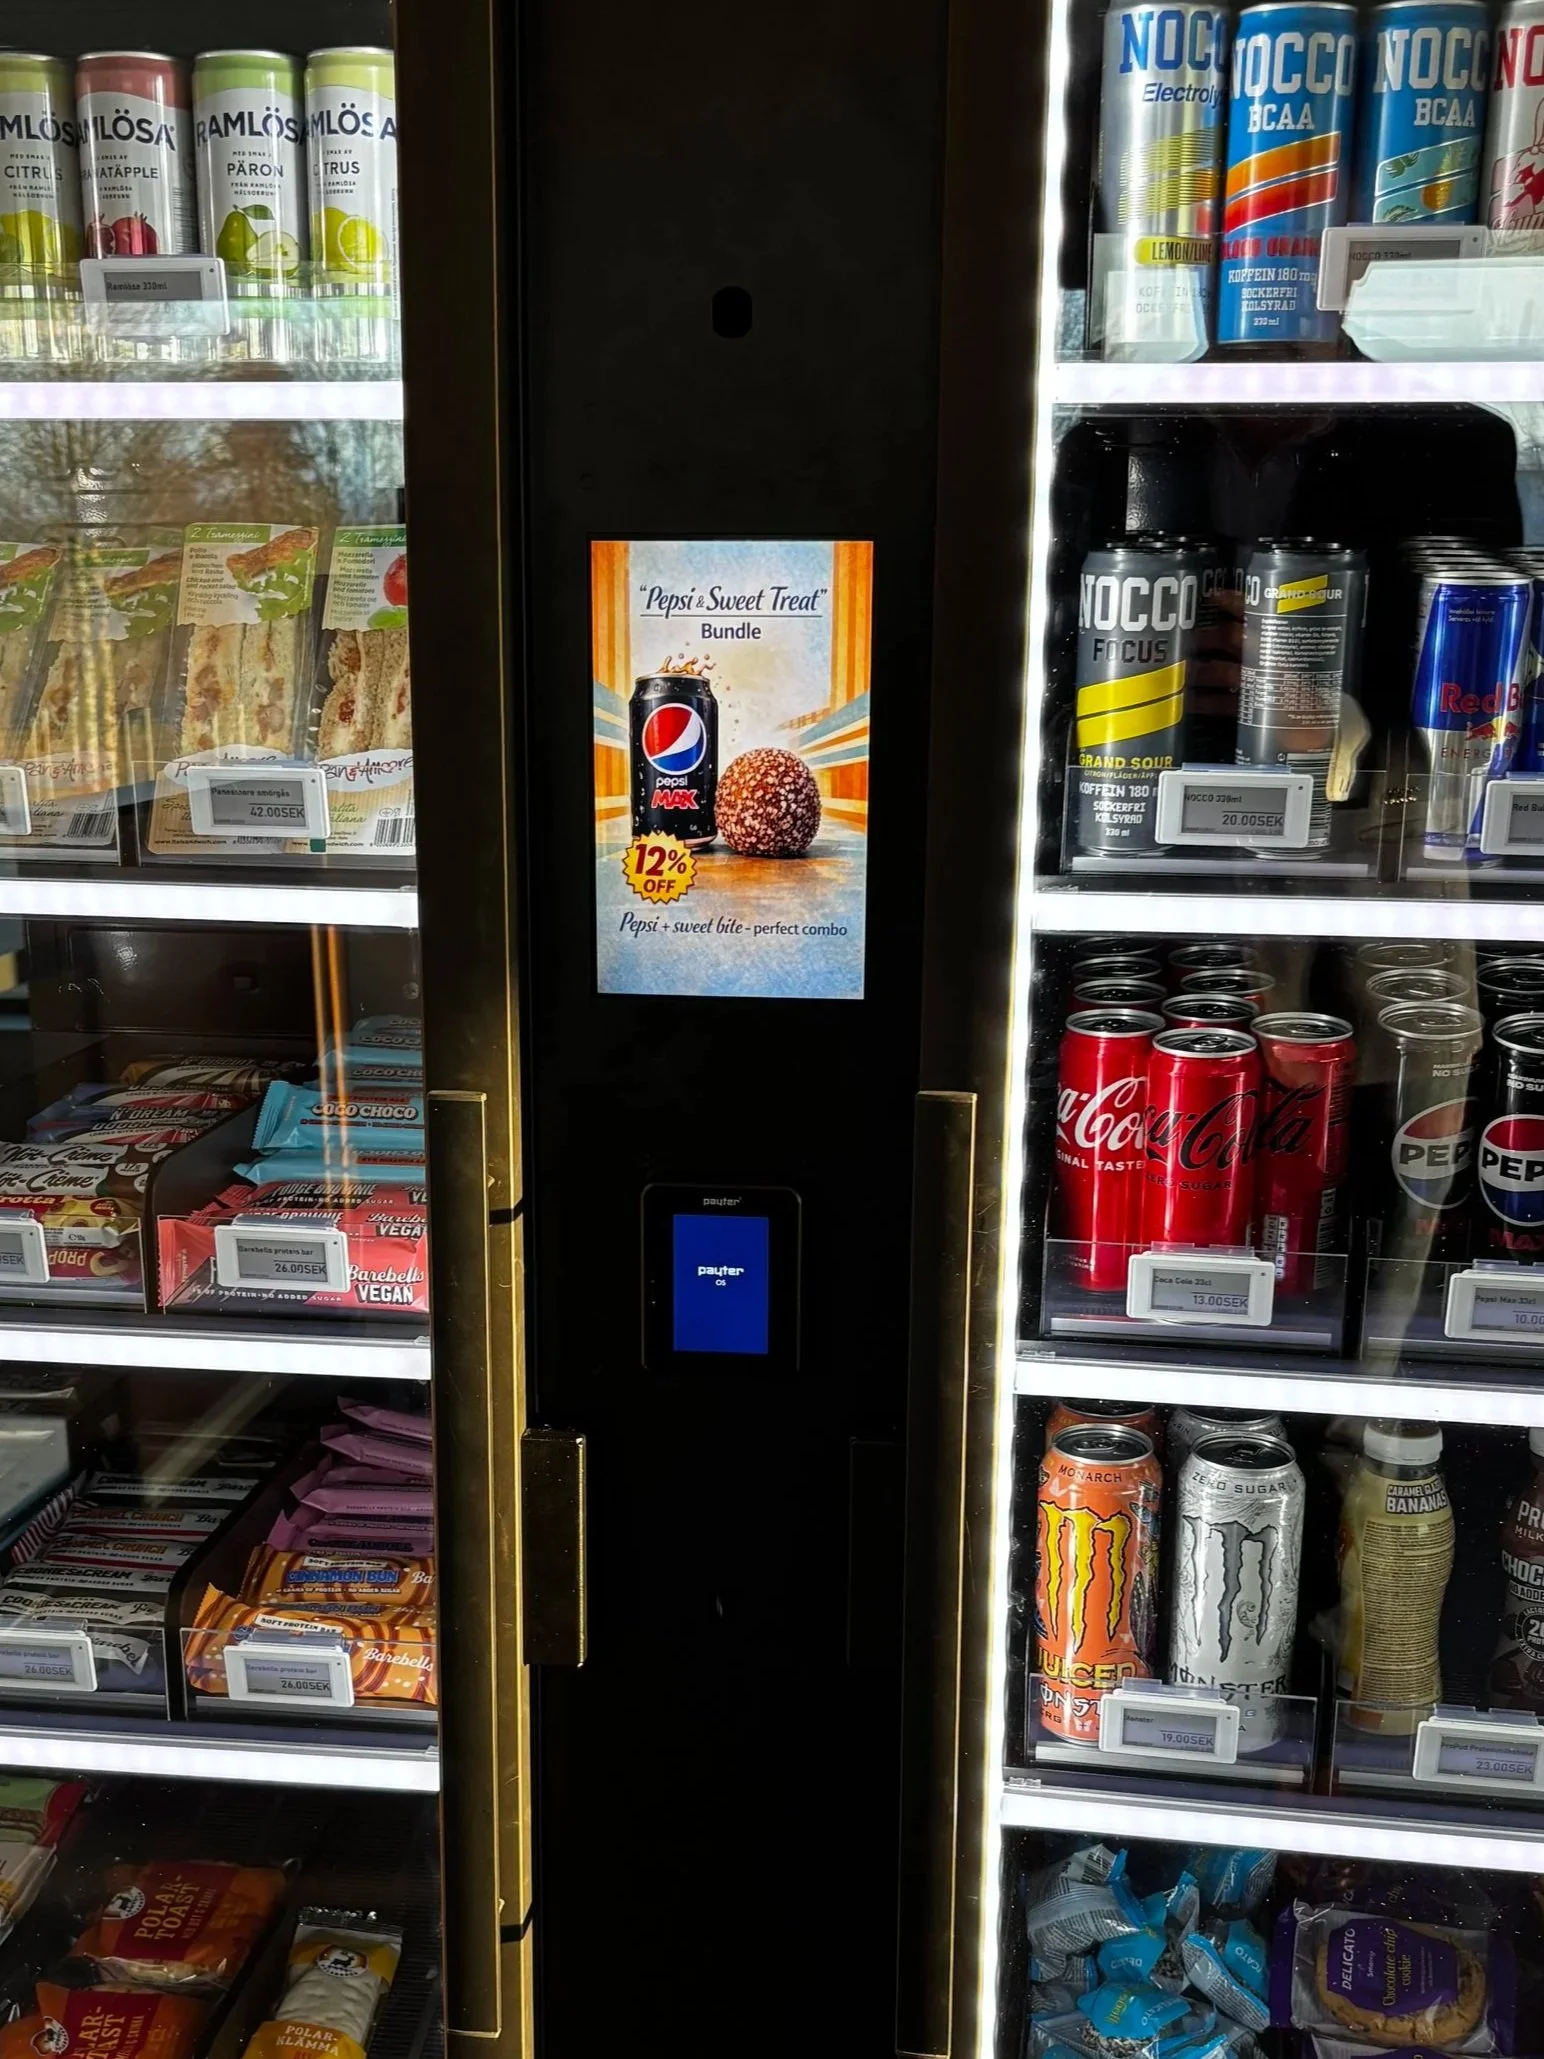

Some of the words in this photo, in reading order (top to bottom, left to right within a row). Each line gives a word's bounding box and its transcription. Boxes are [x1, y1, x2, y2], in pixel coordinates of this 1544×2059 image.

[1232, 32, 1355, 99] NOCCO
[1247, 103, 1314, 132] BCAA
[1414, 98, 1475, 127] BCAA
[4, 166, 63, 181] CITRUS
[227, 160, 284, 177] PÄRON
[313, 161, 360, 176] CTRUS
[1228, 268, 1275, 284] KOFFEIN
[1277, 268, 1297, 281] 180
[1241, 287, 1297, 299] SOCKERFRI
[696, 596, 706, 608] &
[706, 585, 767, 611] Sweet
[1079, 574, 1198, 632] NOCCO
[701, 622, 762, 640] Bundle
[1093, 638, 1168, 664] FOCUS
[1440, 682, 1504, 714] Red
[1079, 753, 1126, 769] GRAND
[1130, 755, 1173, 769] SOUR
[656, 776, 688, 788] pepsi
[1079, 781, 1125, 798] KOFFEIN
[1129, 783, 1152, 798] 180
[651, 789, 699, 810] MAX
[1093, 800, 1146, 812] SOCKERFRI
[635, 843, 687, 877] 12%
[643, 879, 676, 894] OFF
[619, 911, 659, 938] Pepsi
[674, 918, 713, 934] sweet
[753, 920, 799, 936] perfect
[802, 919, 848, 936] combo
[313, 1103, 357, 1118] COCO
[359, 1105, 419, 1121] CHOCO
[1096, 1161, 1144, 1171] TASTE
[703, 1197, 740, 1206] payter
[348, 1264, 424, 1283] Barebells
[698, 1265, 744, 1276] payter
[1154, 1276, 1173, 1285] Coca
[1175, 1277, 1193, 1286] Cola
[359, 1286, 413, 1303] VEGAN
[1058, 1464, 1122, 1483] MONARCH
[1192, 1470, 1226, 1491] ZERO
[1234, 1481, 1287, 1494] SUGAR
[1388, 1484, 1424, 1498] CARAMEL
[1386, 1491, 1449, 1513] BANANAS
[288, 1570, 363, 1584] CINNAMON
[365, 1571, 399, 1583] BUN
[364, 1647, 433, 1672] Barebells
[153, 1882, 200, 1941] TOAST
[1384, 1928, 1399, 1953] chip
[1341, 1927, 1356, 1991] DELICATO
[1399, 1953, 1413, 1987] cookie
[1382, 1954, 1397, 2007] Chocolate
[284, 2024, 339, 2042] POLAR-
[275, 2034, 340, 2056] KLÄMMA
